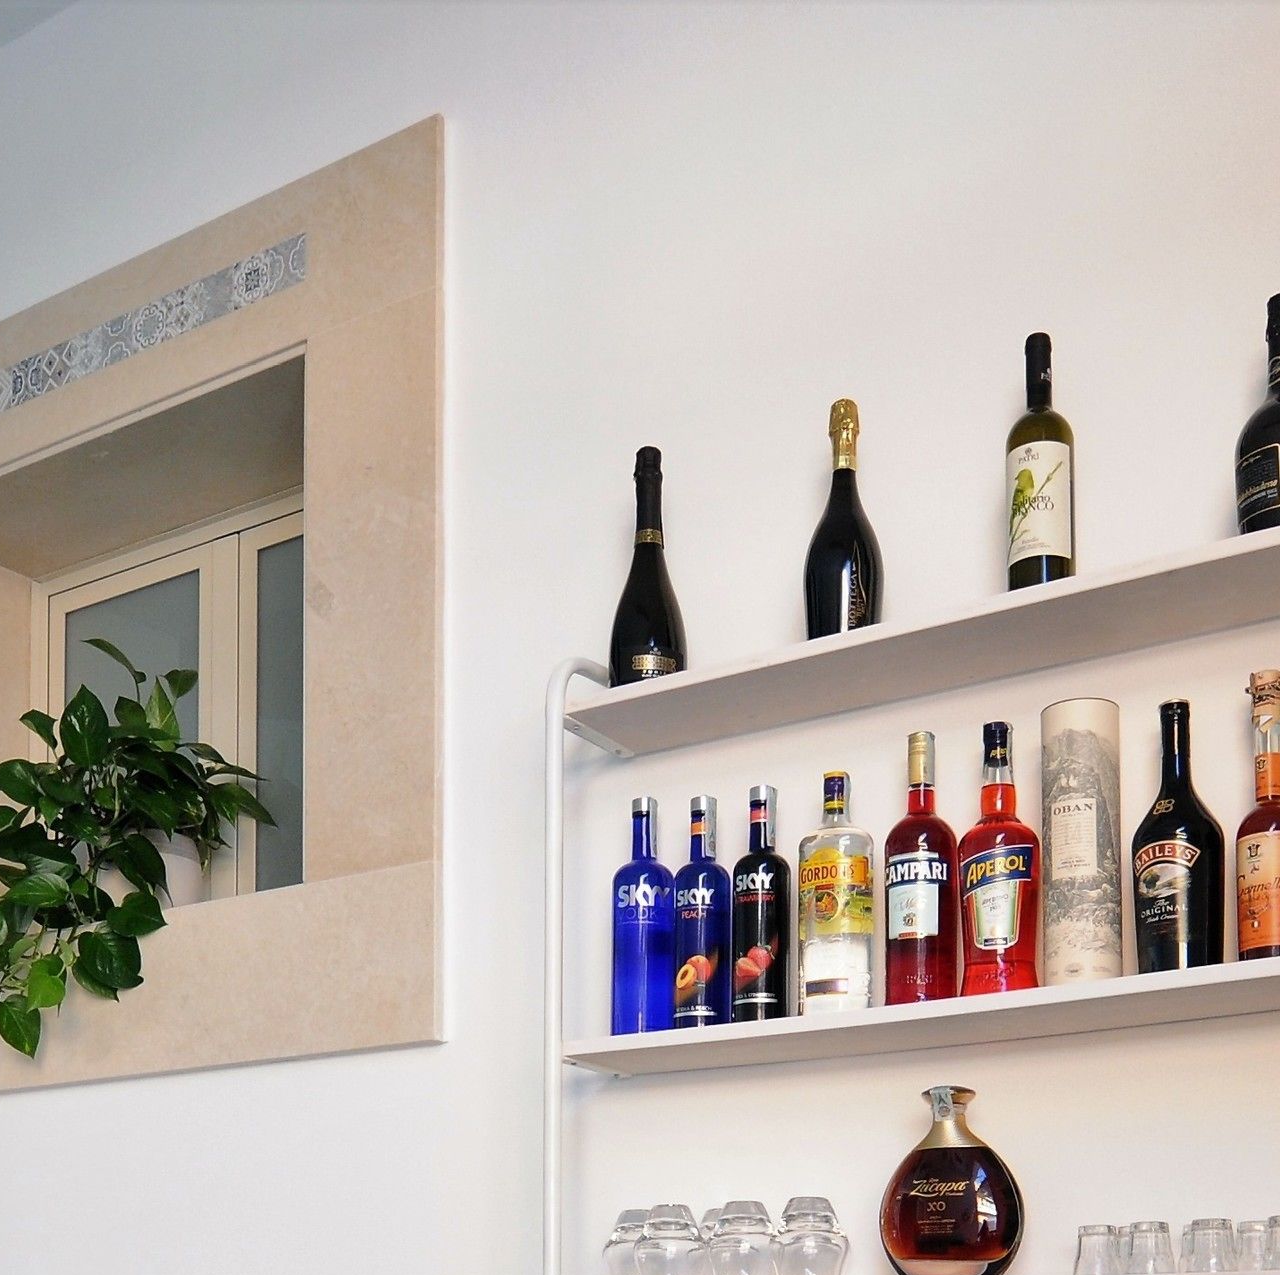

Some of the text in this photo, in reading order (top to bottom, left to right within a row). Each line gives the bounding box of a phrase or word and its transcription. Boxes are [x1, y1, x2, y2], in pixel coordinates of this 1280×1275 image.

[1053, 803, 1094, 816] OBAN
[1135, 845, 1196, 870] BAILEYS
[966, 855, 1026, 888] APEROL
[735, 872, 774, 892] SKYY
[677, 888, 714, 907] SKYY
[681, 909, 707, 920] PEACH
[1141, 904, 1188, 919] ORIGINAL
[910, 1180, 969, 1197] Zacapa
[927, 1201, 946, 1212] XO
